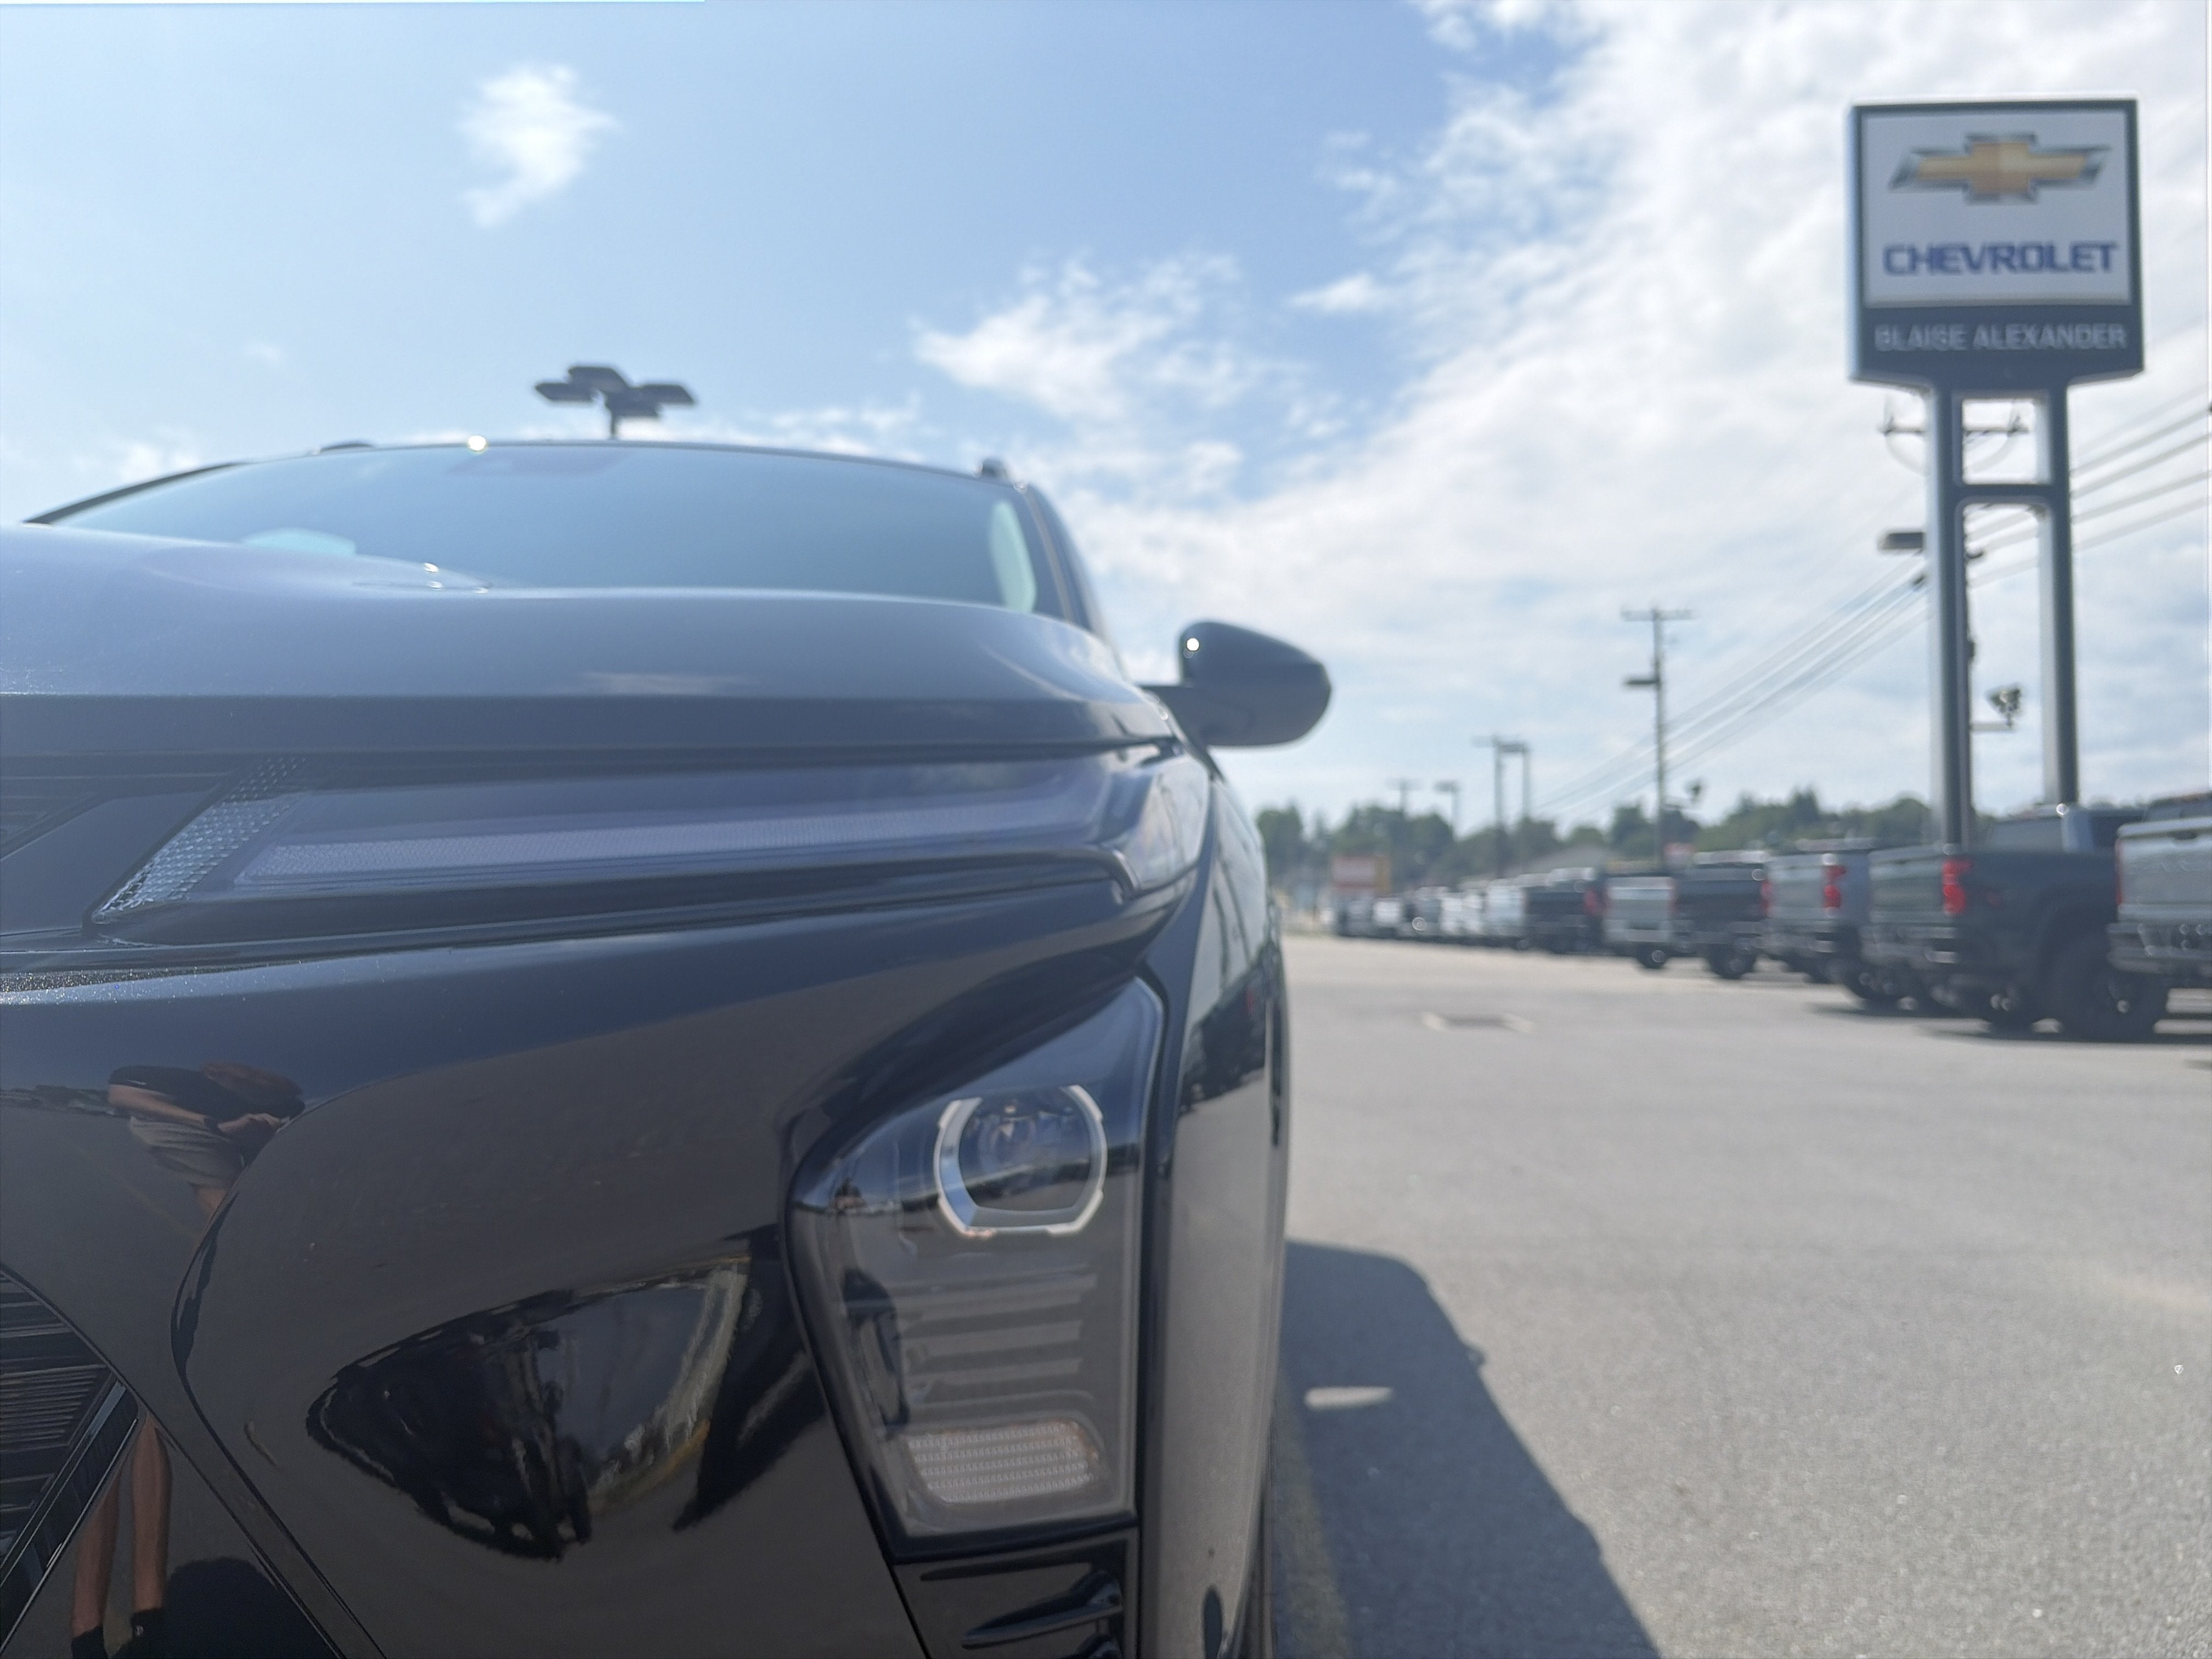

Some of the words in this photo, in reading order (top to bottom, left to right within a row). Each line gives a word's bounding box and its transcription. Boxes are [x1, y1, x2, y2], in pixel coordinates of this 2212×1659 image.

[1883, 242, 2118, 274] CHEVROLET
[1875, 325, 1967, 351] BLAISE
[1974, 324, 2126, 350] ALEXANDER
